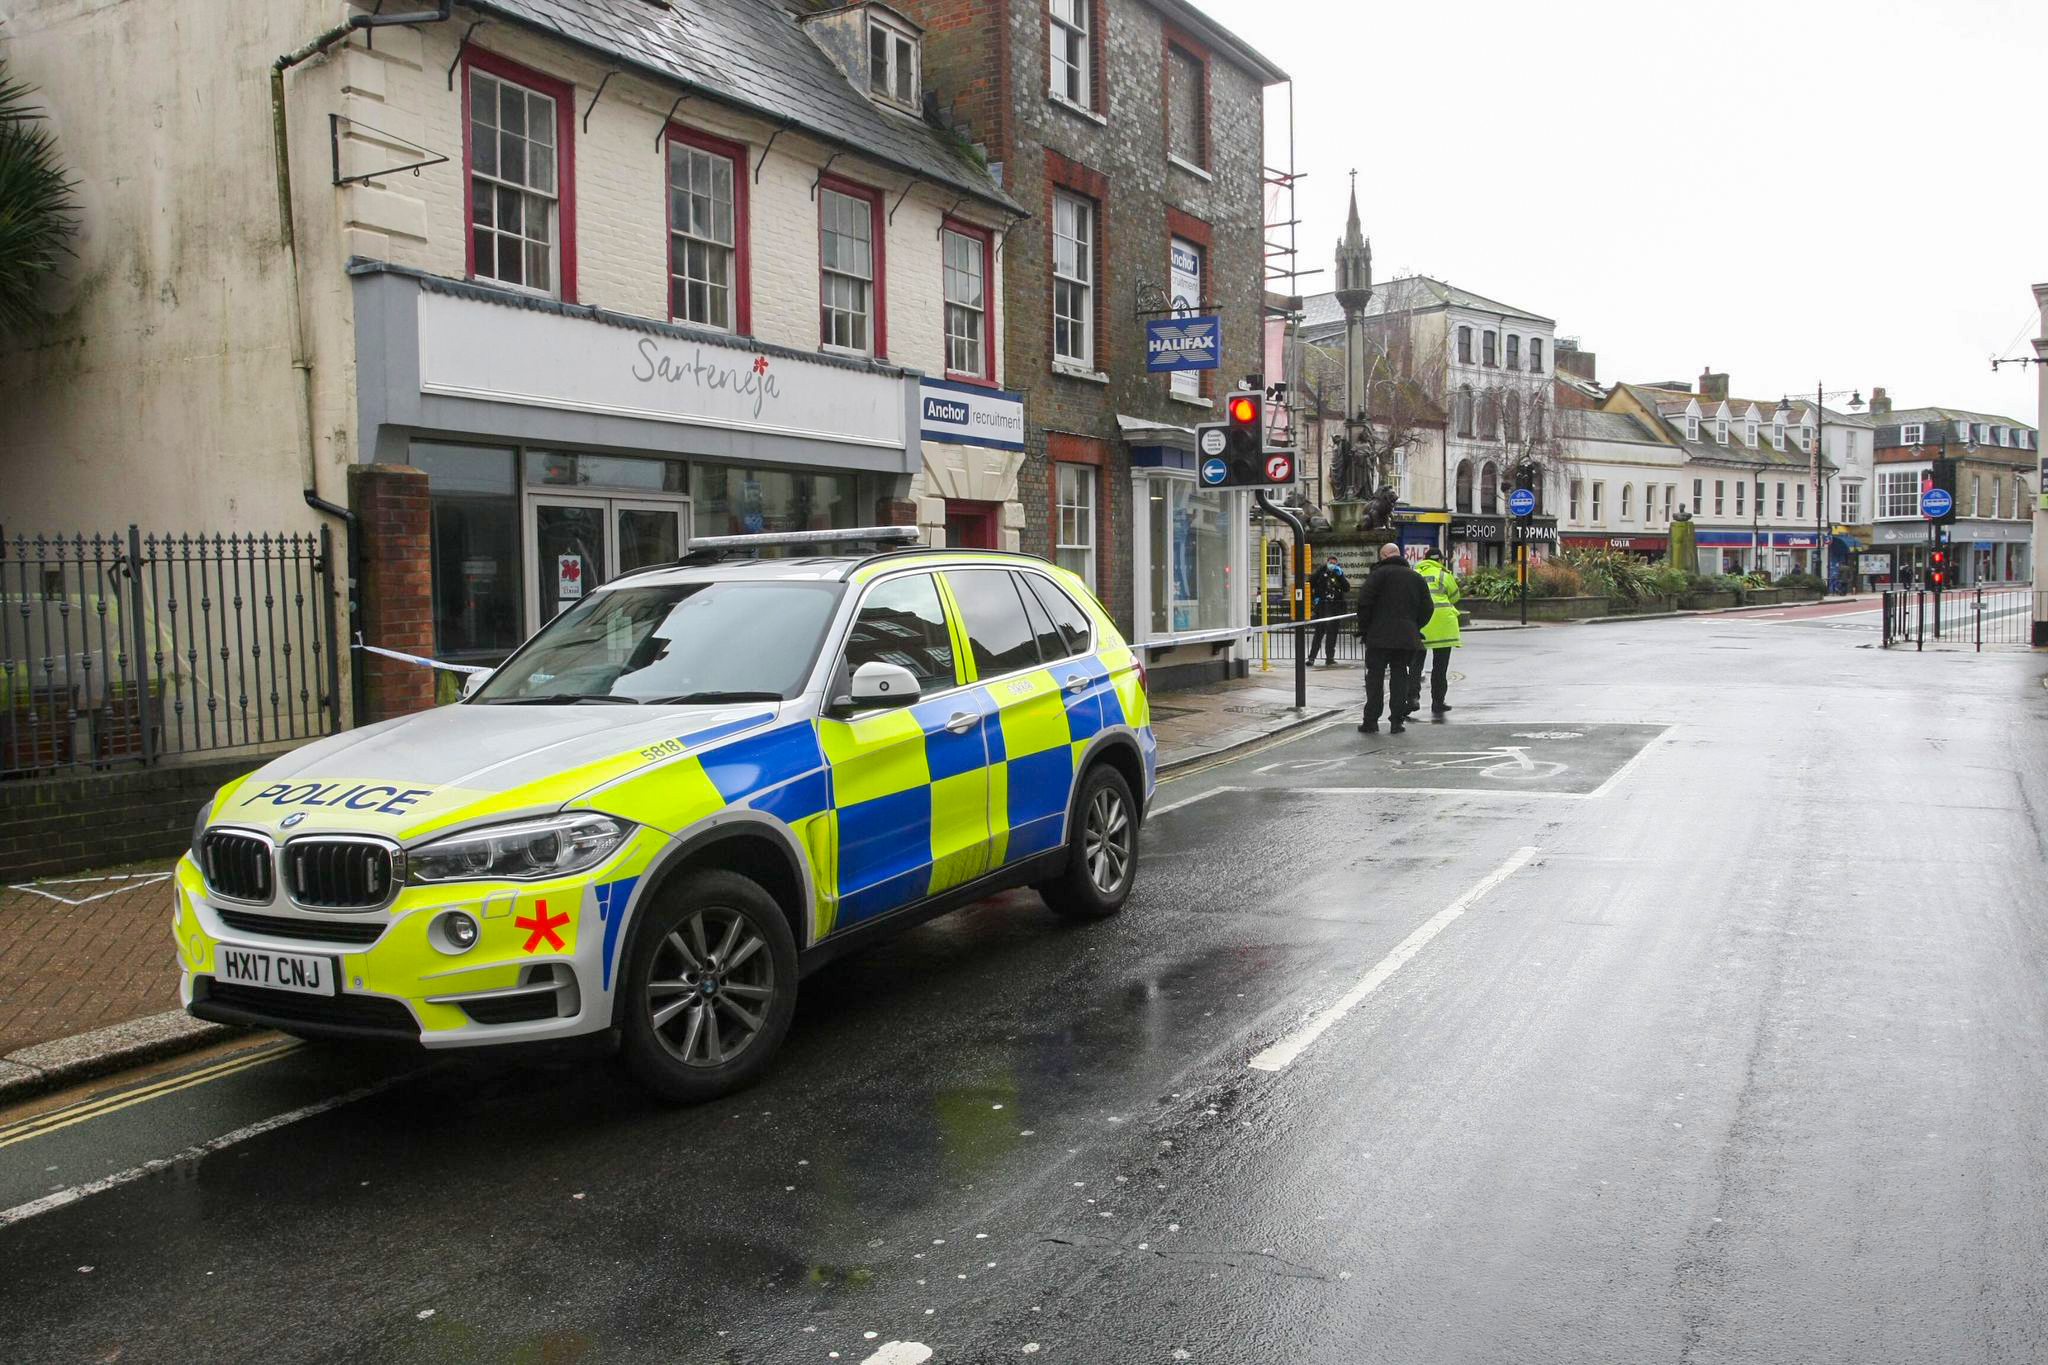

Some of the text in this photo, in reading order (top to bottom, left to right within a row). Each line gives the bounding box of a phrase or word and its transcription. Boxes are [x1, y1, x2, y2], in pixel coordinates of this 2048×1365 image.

[1149, 336, 1215, 352] HALIFAX
[632, 338, 780, 420] Sarteneja
[928, 401, 1021, 430] Anchor recruitment
[1466, 525, 1496, 538] PSHOP
[1897, 526, 1935, 539] Santan
[641, 740, 680, 760] 5818
[240, 784, 433, 815] POLICE
[225, 951, 320, 988] HX17 CNJ
